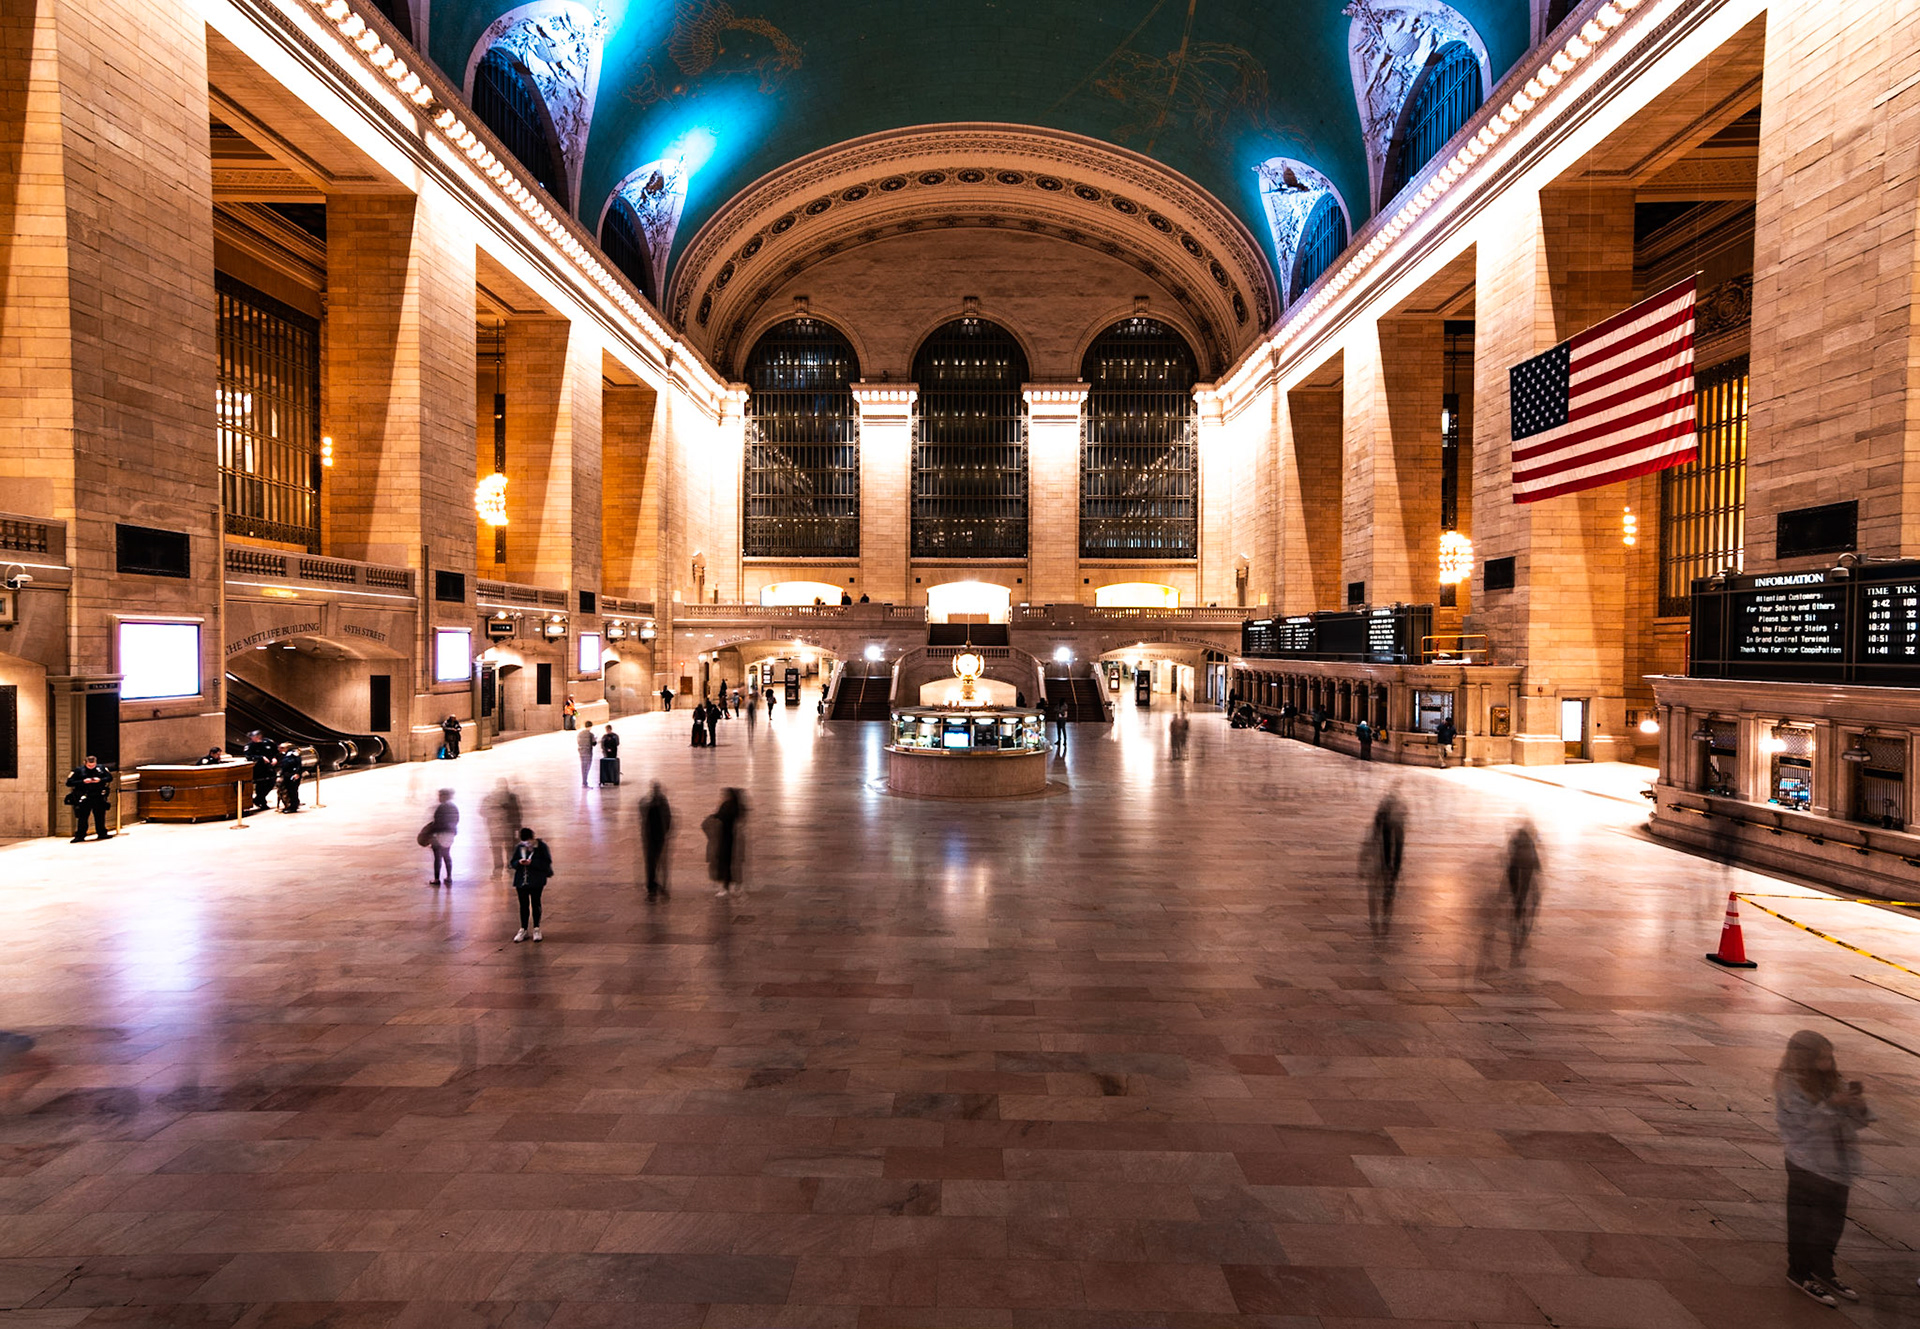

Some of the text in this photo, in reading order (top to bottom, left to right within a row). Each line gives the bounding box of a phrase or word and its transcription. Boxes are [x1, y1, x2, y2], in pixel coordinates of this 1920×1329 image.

[1755, 573, 1824, 587] INFORMATION
[1866, 585, 1917, 595] TIME TRK
[1756, 594, 1786, 602] Attention
[1775, 604, 1796, 612] Safety
[243, 627, 281, 646] METLIFE
[282, 622, 320, 635] BUILDING
[343, 624, 386, 642] 45TH STREET
[1801, 635, 1830, 643] Terminal
